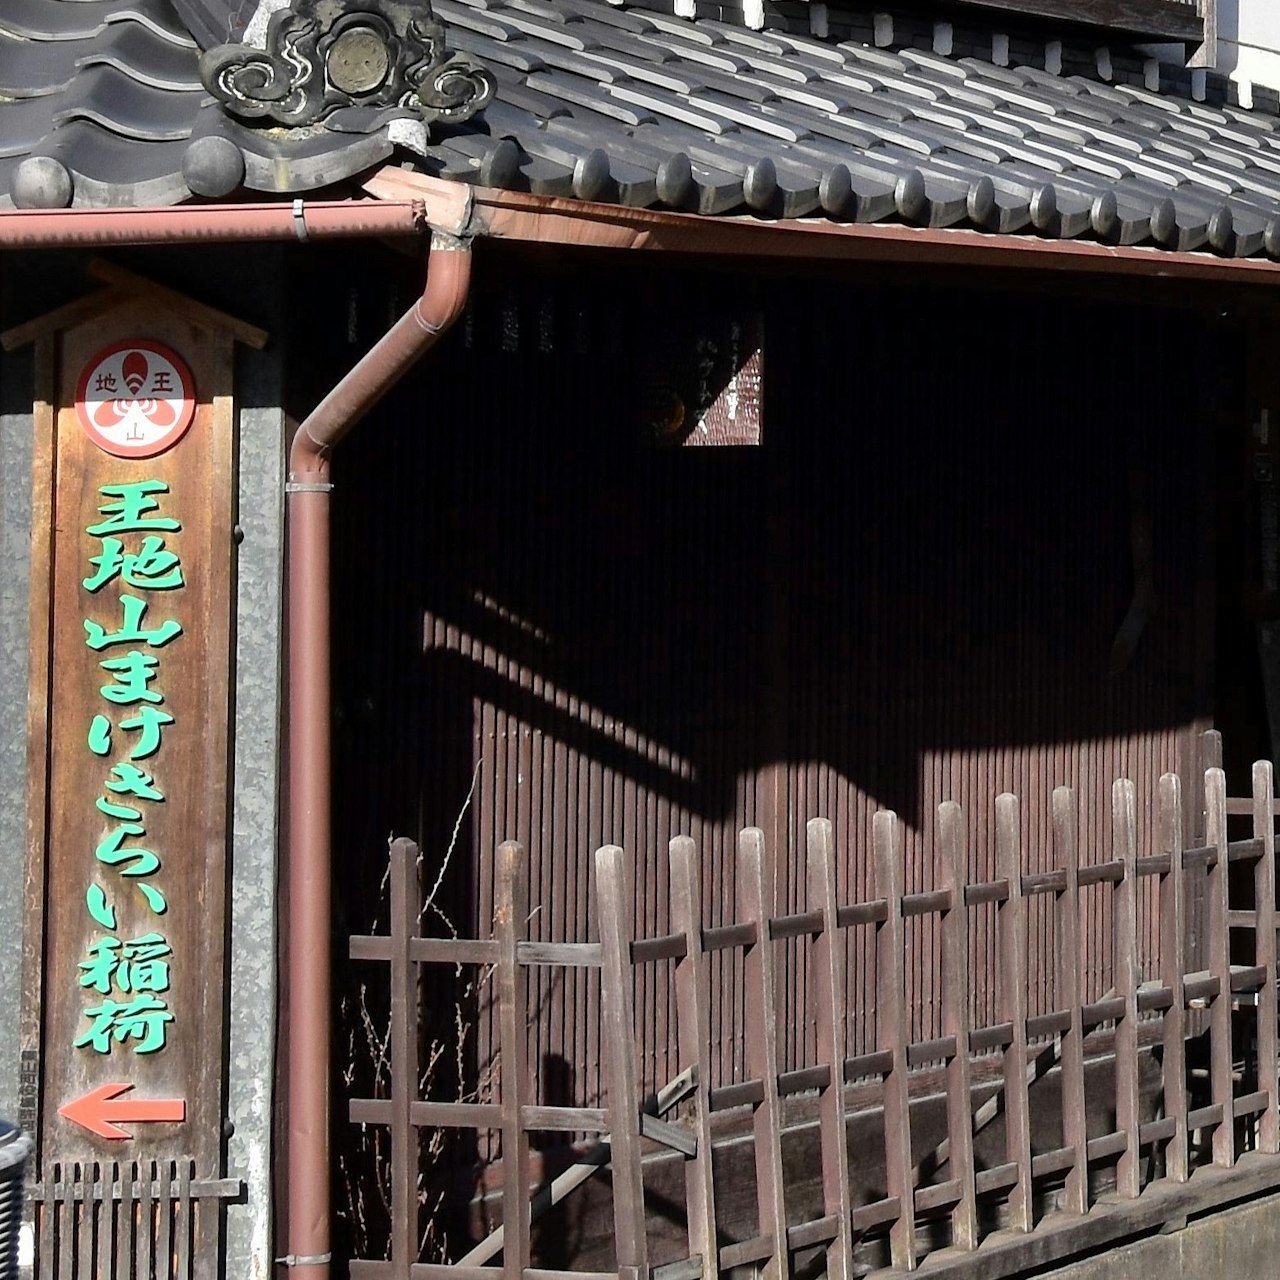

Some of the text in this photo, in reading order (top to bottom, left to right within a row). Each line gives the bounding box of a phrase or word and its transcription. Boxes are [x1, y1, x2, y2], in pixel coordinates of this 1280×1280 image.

[74, 481, 184, 1055] 王地山まけきらい稲荷
